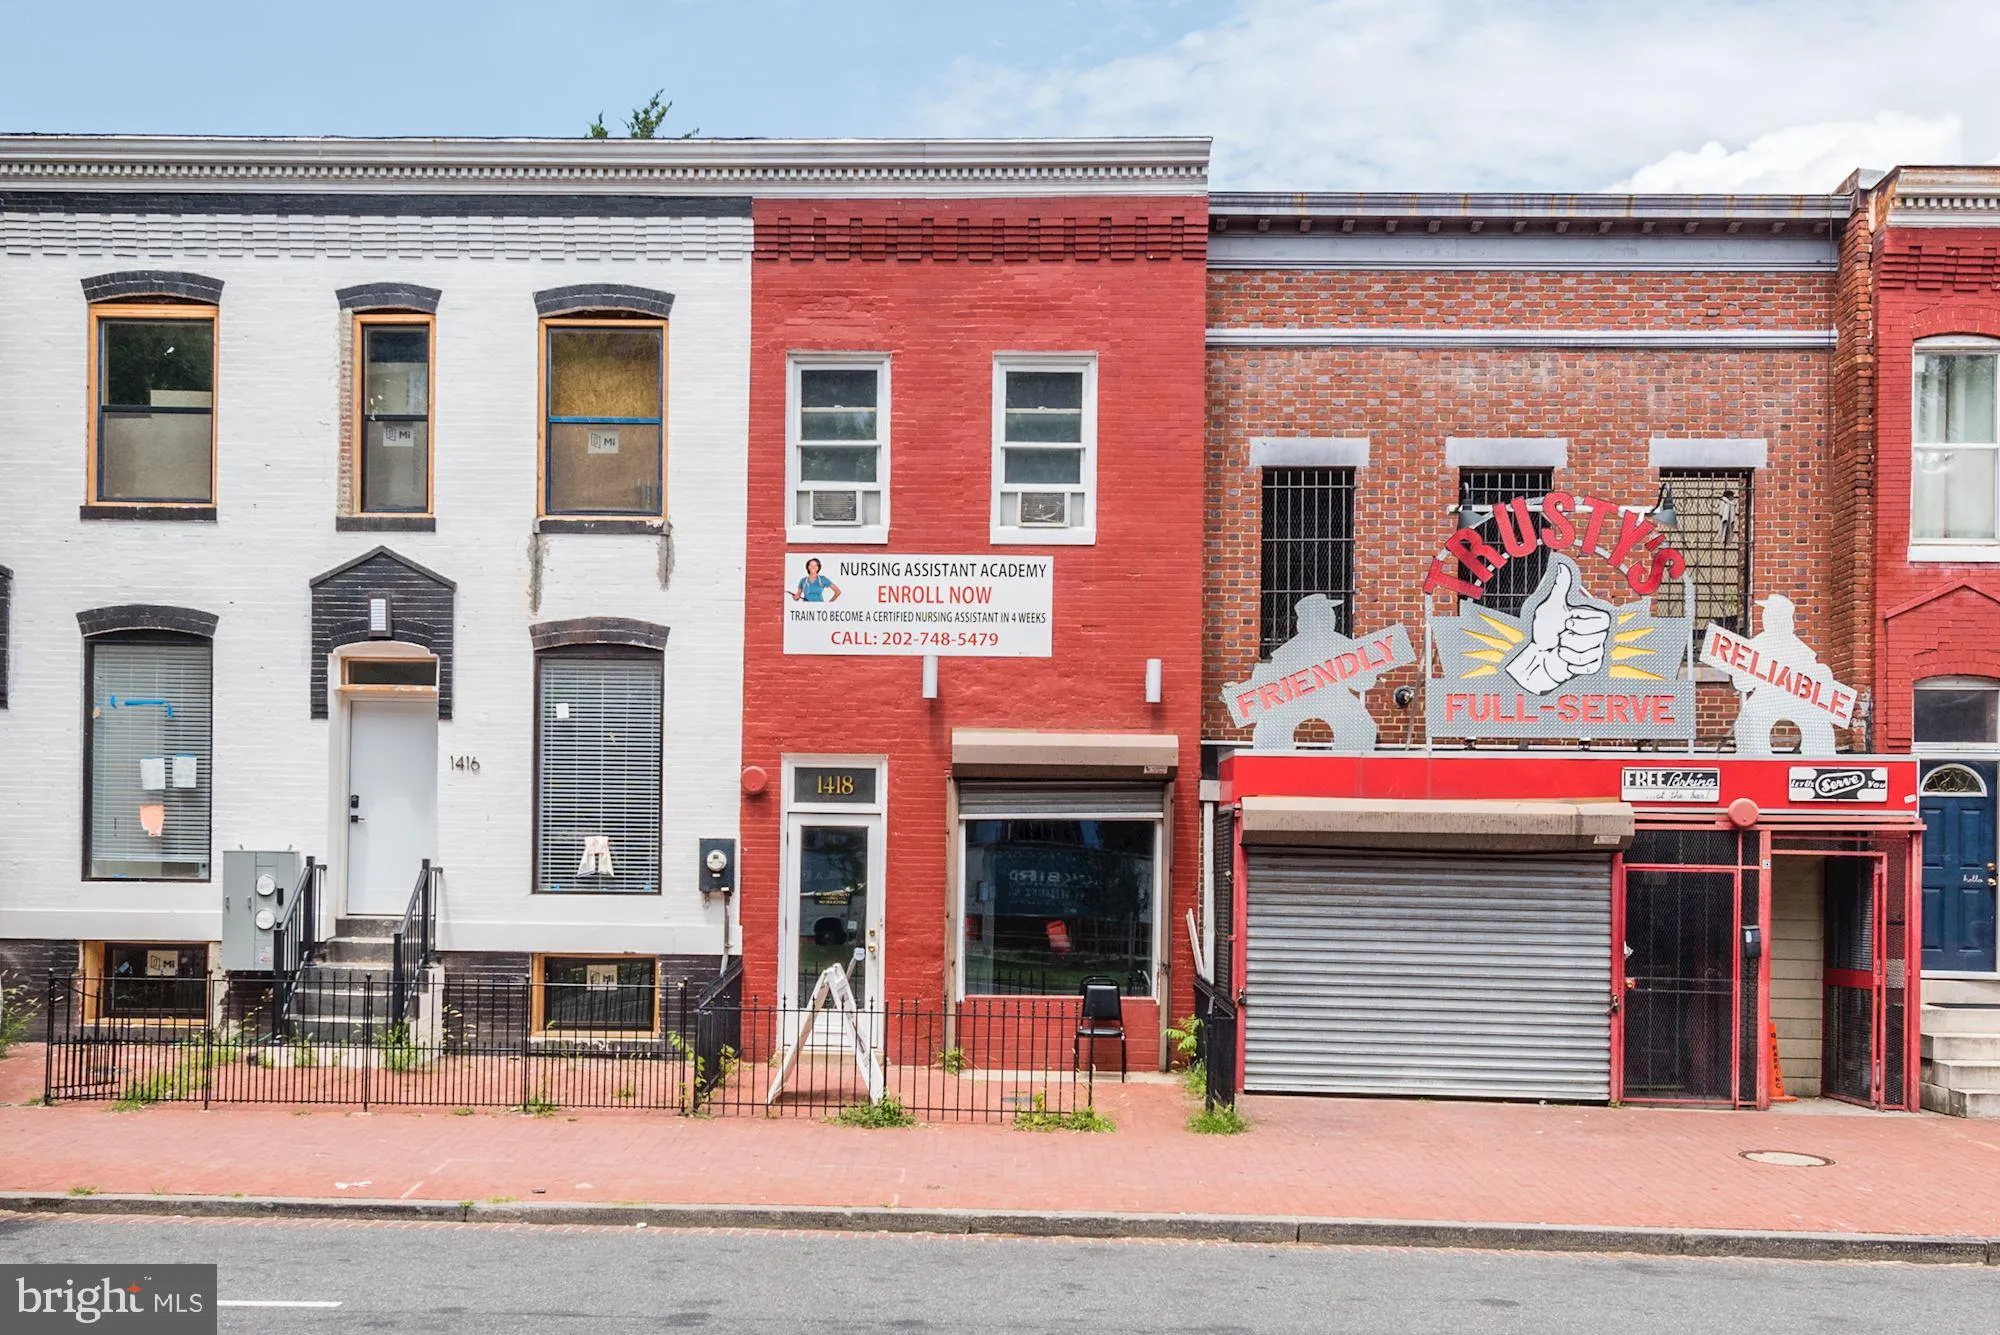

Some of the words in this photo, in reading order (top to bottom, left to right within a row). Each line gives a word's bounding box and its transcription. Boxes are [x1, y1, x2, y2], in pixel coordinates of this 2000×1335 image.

[1422, 491, 1686, 600] TRUSTY'S
[840, 562, 900, 577] NURSING
[904, 563, 977, 578] ASSISTANT
[980, 563, 1047, 579] ACADEMY
[877, 585, 944, 604] ENROLL
[949, 586, 993, 605] NOW
[790, 610, 815, 622] TRAIN
[817, 610, 828, 622] TO
[829, 610, 864, 622] BECOME
[865, 611, 872, 622] A
[872, 611, 915, 623] CERTIFIED
[915, 611, 953, 623] NURSING
[954, 612, 999, 624] ASSISTANT
[1000, 612, 1010, 624] IN
[1011, 612, 1017, 624] 4
[1018, 612, 1047, 624] WEEKS
[831, 631, 878, 646] CALL:
[882, 632, 999, 647] 202-748-5479
[1236, 634, 1395, 720] FRIENDLY
[1710, 632, 1852, 720] RELIABLE
[1445, 693, 1677, 725] FULL-SERVE
[450, 755, 480, 772] 1416
[817, 775, 854, 795] 1418
[1624, 771, 1667, 787] FREE
[1667, 772, 1717, 789] Parking
[1821, 775, 1860, 792] Serve
[1867, 780, 1886, 788] You
[1963, 874, 1984, 883] hello
